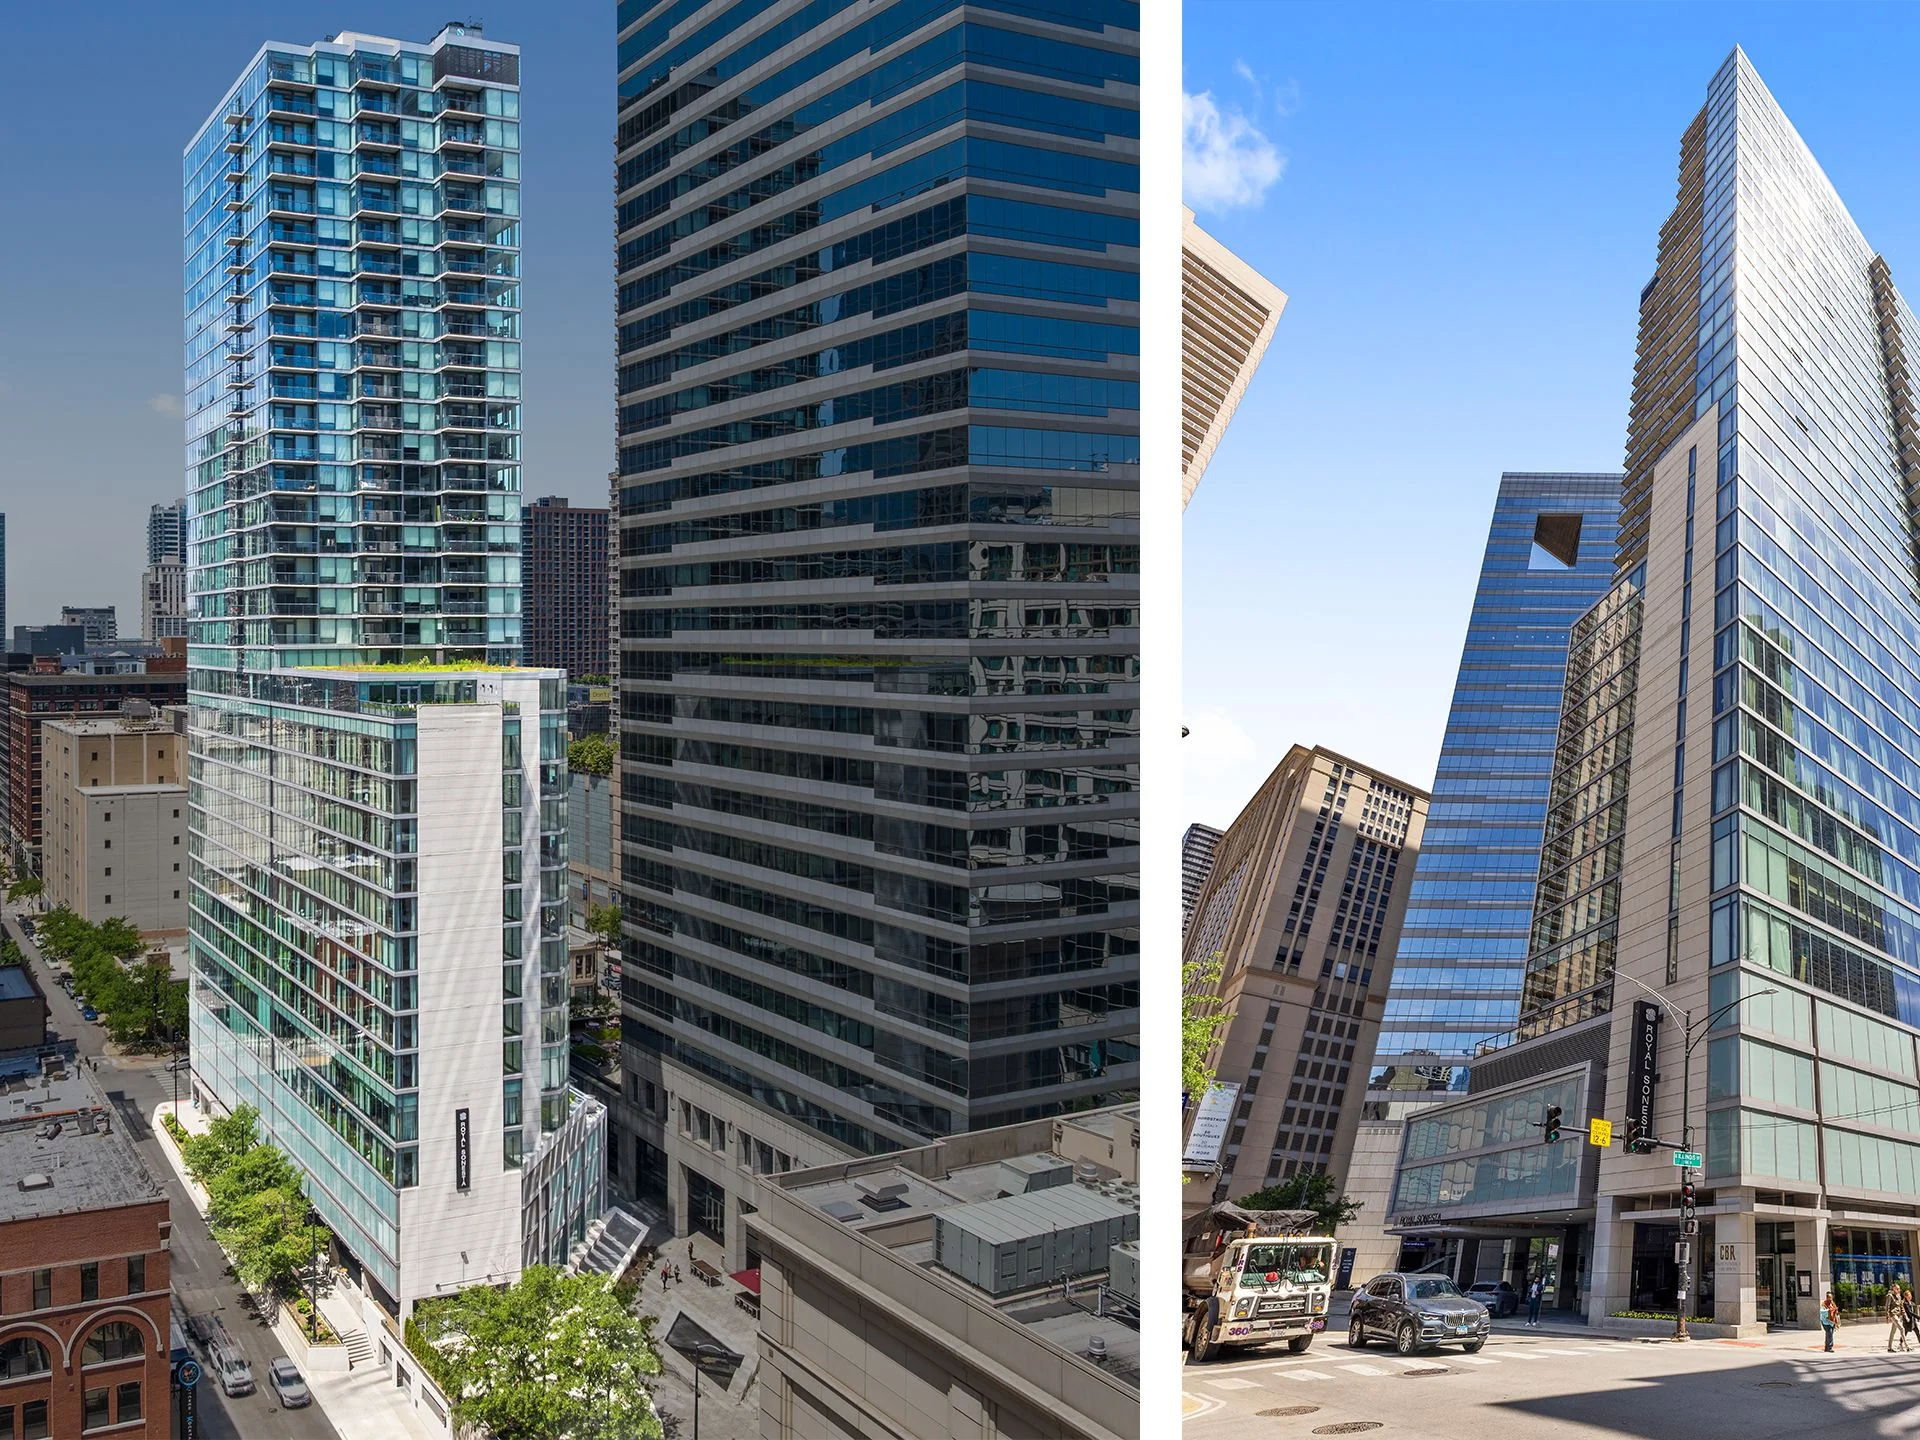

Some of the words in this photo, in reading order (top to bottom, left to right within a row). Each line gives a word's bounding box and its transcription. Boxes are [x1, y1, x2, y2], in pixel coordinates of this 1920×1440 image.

[1645, 1024, 1653, 1070] ROYAL
[1640, 1075, 1651, 1146] SONEST
[1719, 1245, 1736, 1261] CBR
[1228, 1326, 1249, 1336] 360
